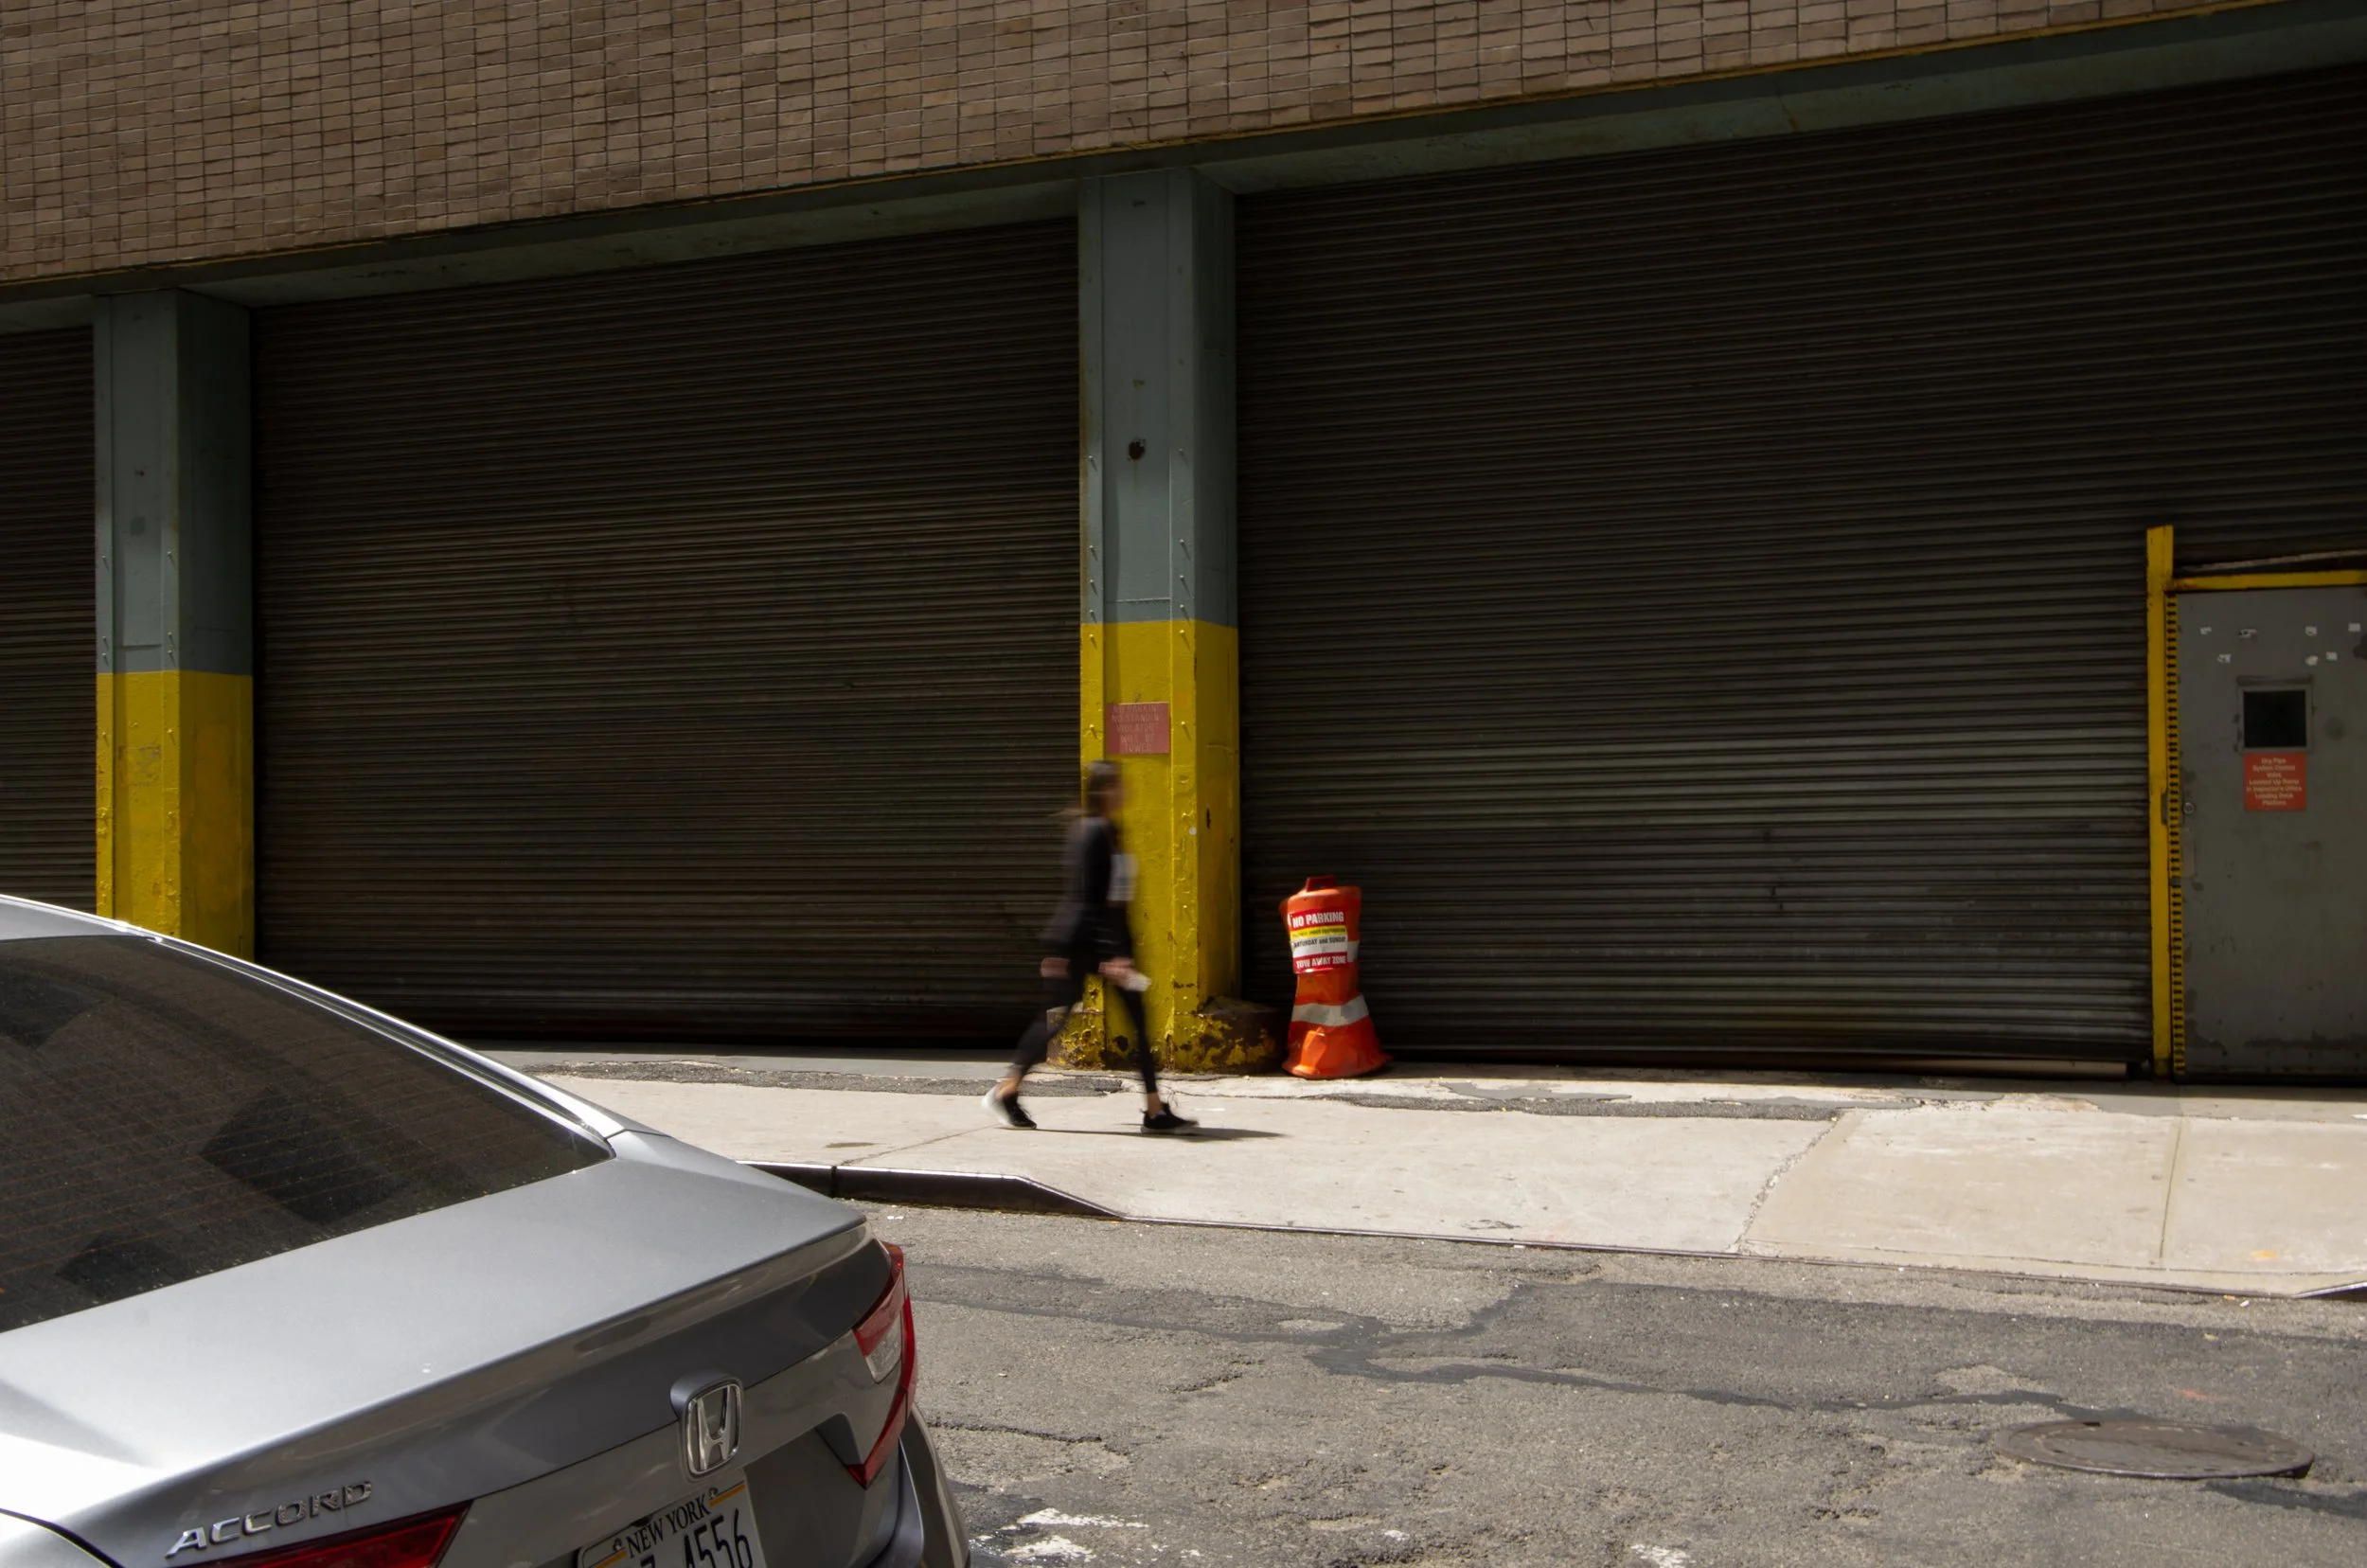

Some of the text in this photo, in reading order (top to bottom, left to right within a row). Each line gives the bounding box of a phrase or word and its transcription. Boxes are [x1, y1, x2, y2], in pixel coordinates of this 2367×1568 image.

[1125, 713, 1161, 722] STANDIN
[1117, 722, 1157, 733] VIOLATOR
[1291, 912, 1344, 929] NO PARKING
[1296, 955, 1346, 970] TOW AWAY ZONE
[165, 1480, 372, 1559] ACCORD
[625, 1493, 712, 1559] NEW YORK
